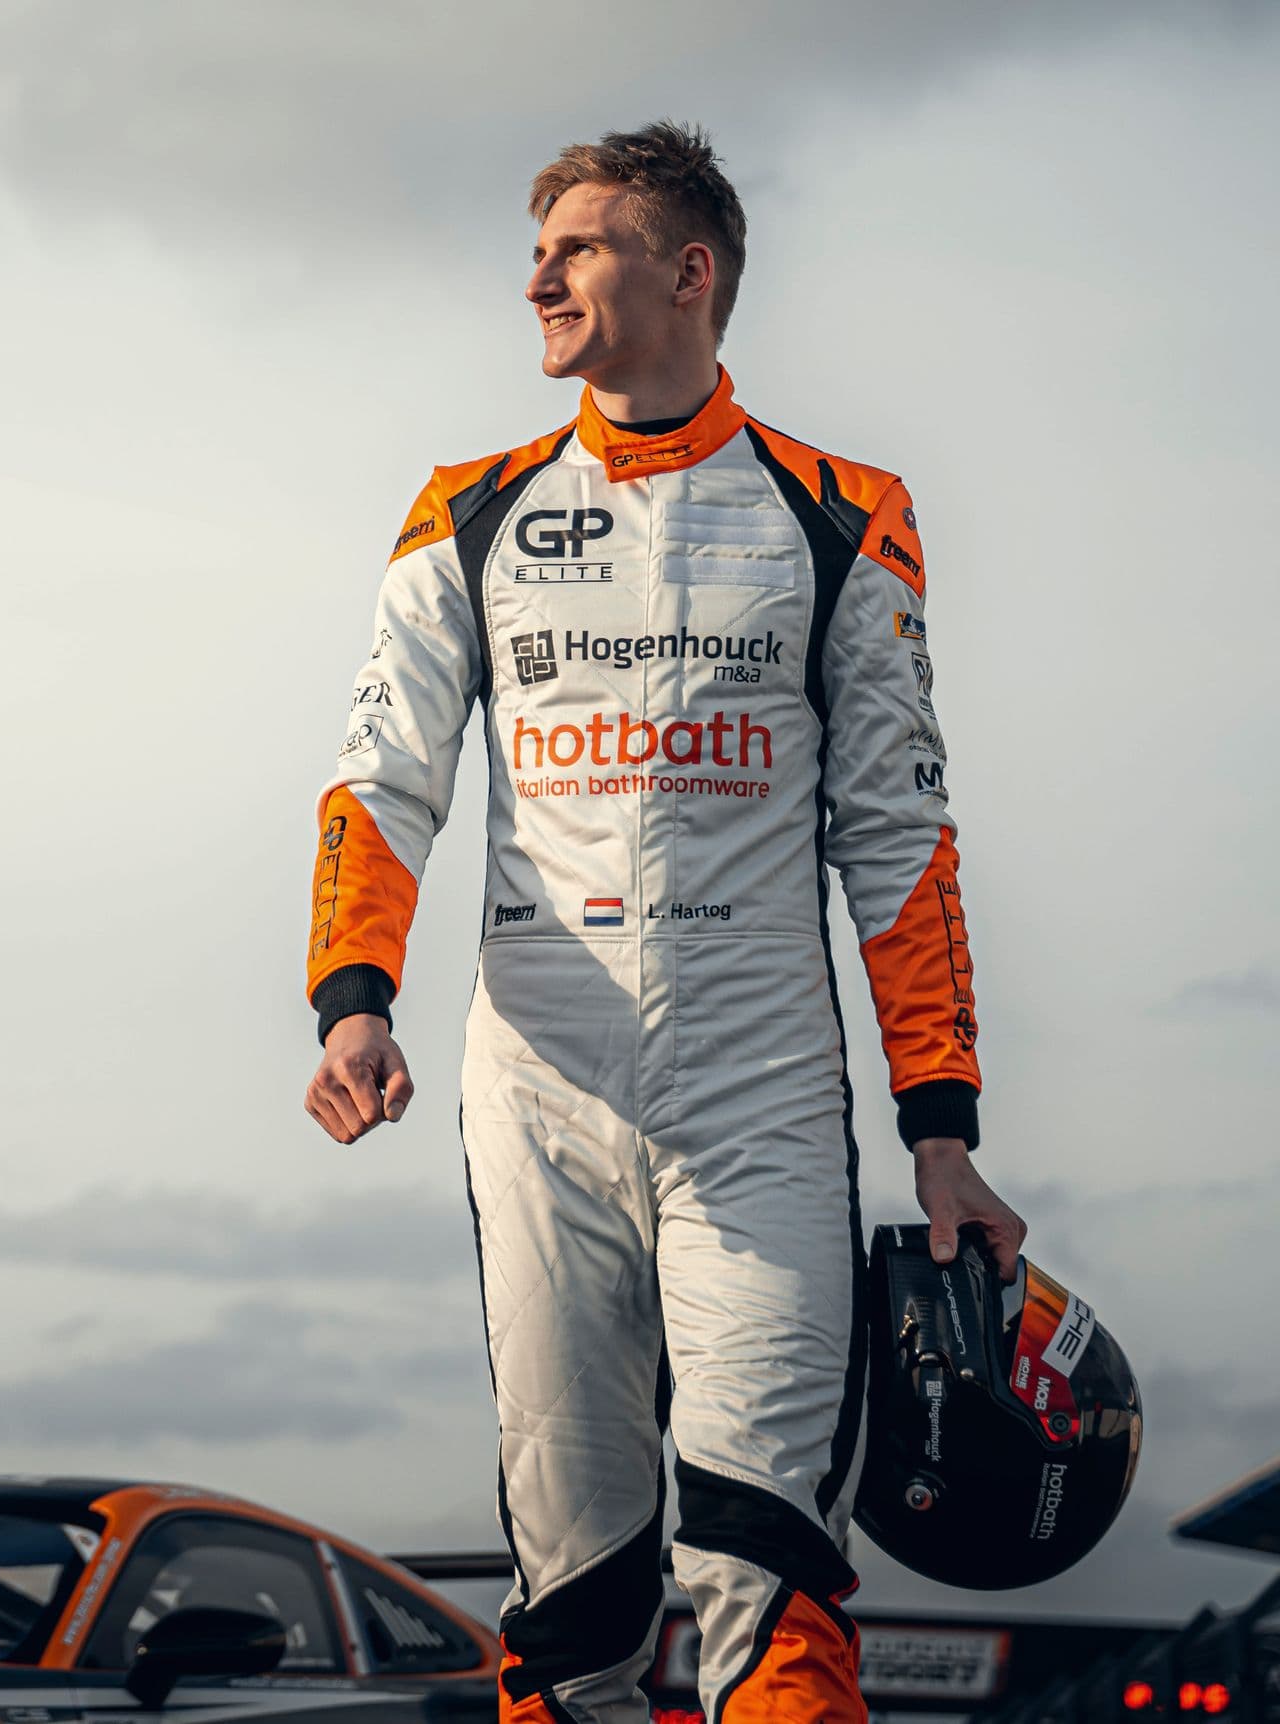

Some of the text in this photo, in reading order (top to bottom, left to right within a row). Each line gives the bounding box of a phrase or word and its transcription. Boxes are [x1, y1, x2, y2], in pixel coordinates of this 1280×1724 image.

[612, 453, 634, 468] GP
[515, 508, 614, 557] GP
[515, 566, 613, 580] ELITE
[565, 626, 783, 669] Hogenhouck
[713, 665, 761, 684] m&a
[513, 711, 772, 769] hotbath
[516, 774, 770, 798] italian bathroomware
[648, 903, 731, 921] L. Hartog
[1034, 1375, 1051, 1411] MOB
[928, 1398, 942, 1462] Hogenhouck
[1037, 1463, 1068, 1540] hotbath
